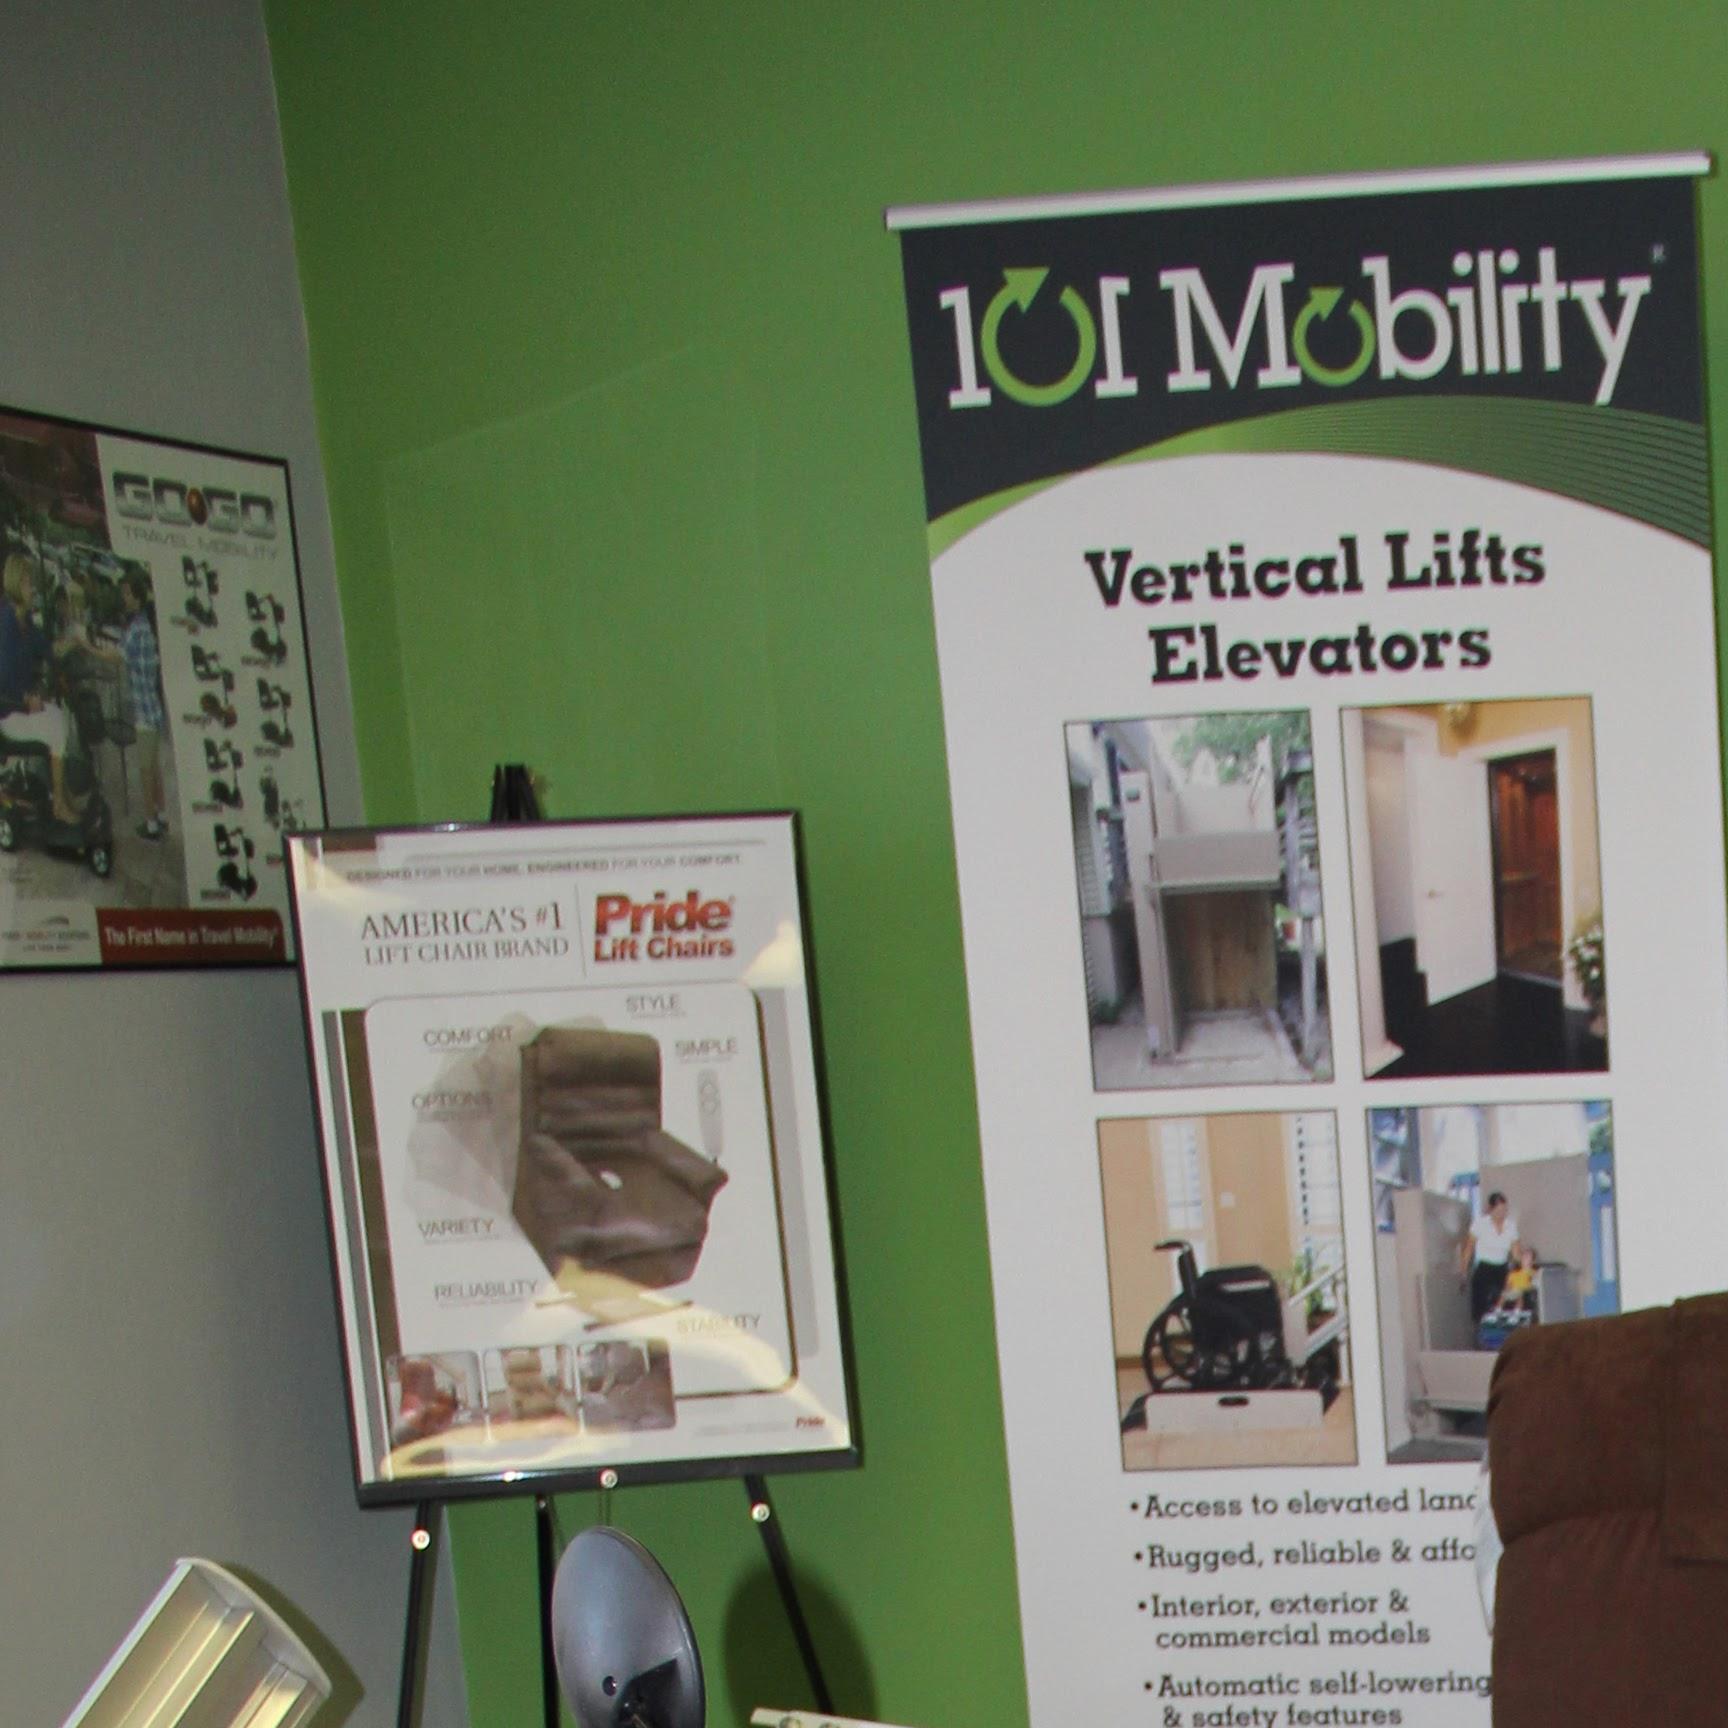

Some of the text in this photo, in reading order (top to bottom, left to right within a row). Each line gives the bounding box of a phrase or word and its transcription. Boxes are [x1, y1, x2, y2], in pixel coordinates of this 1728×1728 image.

[939, 246, 1651, 408] 101 Mobility
[1084, 529, 1547, 607] Vertical Lifts
[1148, 624, 1493, 686] Elevators
[361, 901, 562, 940] AMERICA'S #1
[596, 889, 733, 935] Pride
[365, 937, 570, 966] LIFT CHAIR BRAND
[594, 934, 735, 962] Lift Chairs
[626, 994, 681, 1012] STYLE
[423, 1026, 515, 1047] COMFORT
[675, 1037, 738, 1055] SIMPLE
[418, 1218, 495, 1238] VARIETY
[434, 1280, 538, 1300] RELIABILITY
[1144, 1495, 1242, 1519] Access
[1252, 1495, 1279, 1516] to
[1287, 1488, 1409, 1515] elevated
[1147, 1544, 1264, 1573] Rugged,
[1272, 1541, 1381, 1565] reliable
[1390, 1539, 1411, 1561] &
[1151, 1588, 1409, 1618] Interior, exterior &
[1156, 1619, 1431, 1649] commercial models
[1158, 1671, 1492, 1701] Automatic self-lowering
[1162, 1706, 1183, 1728] &
[1287, 1702, 1402, 1726] features
